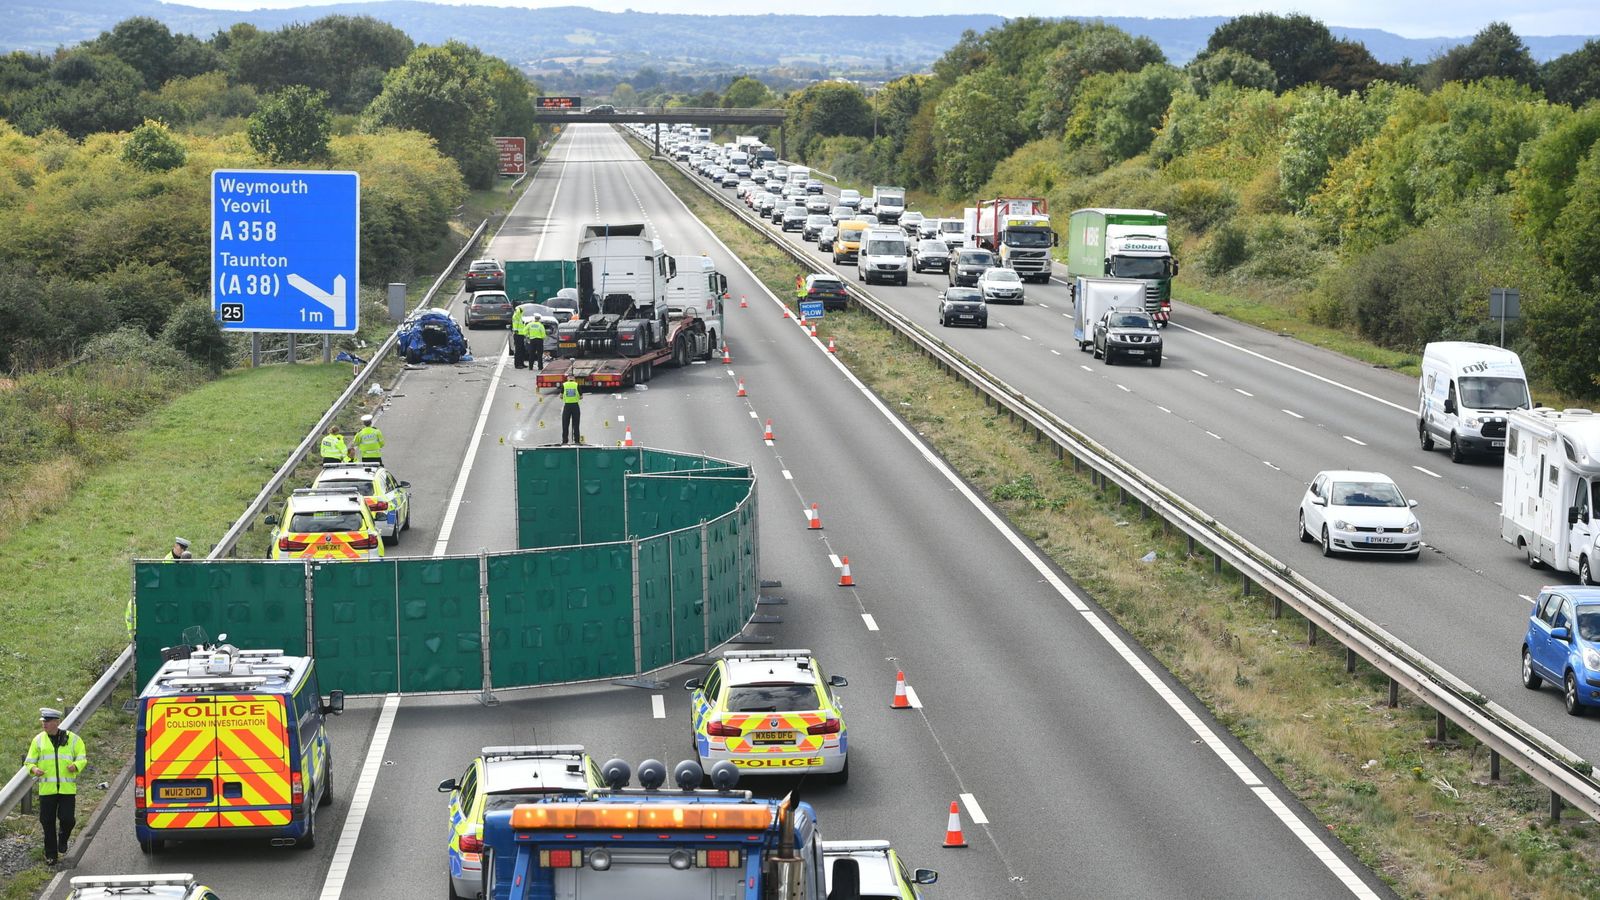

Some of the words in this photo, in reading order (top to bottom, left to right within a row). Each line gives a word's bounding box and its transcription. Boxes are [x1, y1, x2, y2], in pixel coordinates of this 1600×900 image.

[220, 178, 308, 196] Weymouth
[220, 198, 271, 214] Yeovil
[220, 252, 288, 267] Taunton
[223, 307, 242, 319] 25
[299, 307, 323, 322] 1m
[166, 704, 265, 718] POLICE
[166, 720, 207, 729] COLLISION
[208, 718, 266, 728] INVESTIGATION
[755, 731, 777, 739] WX66
[730, 757, 821, 768] POLICE
[164, 788, 184, 797] WU12
[185, 788, 202, 797] DKD
